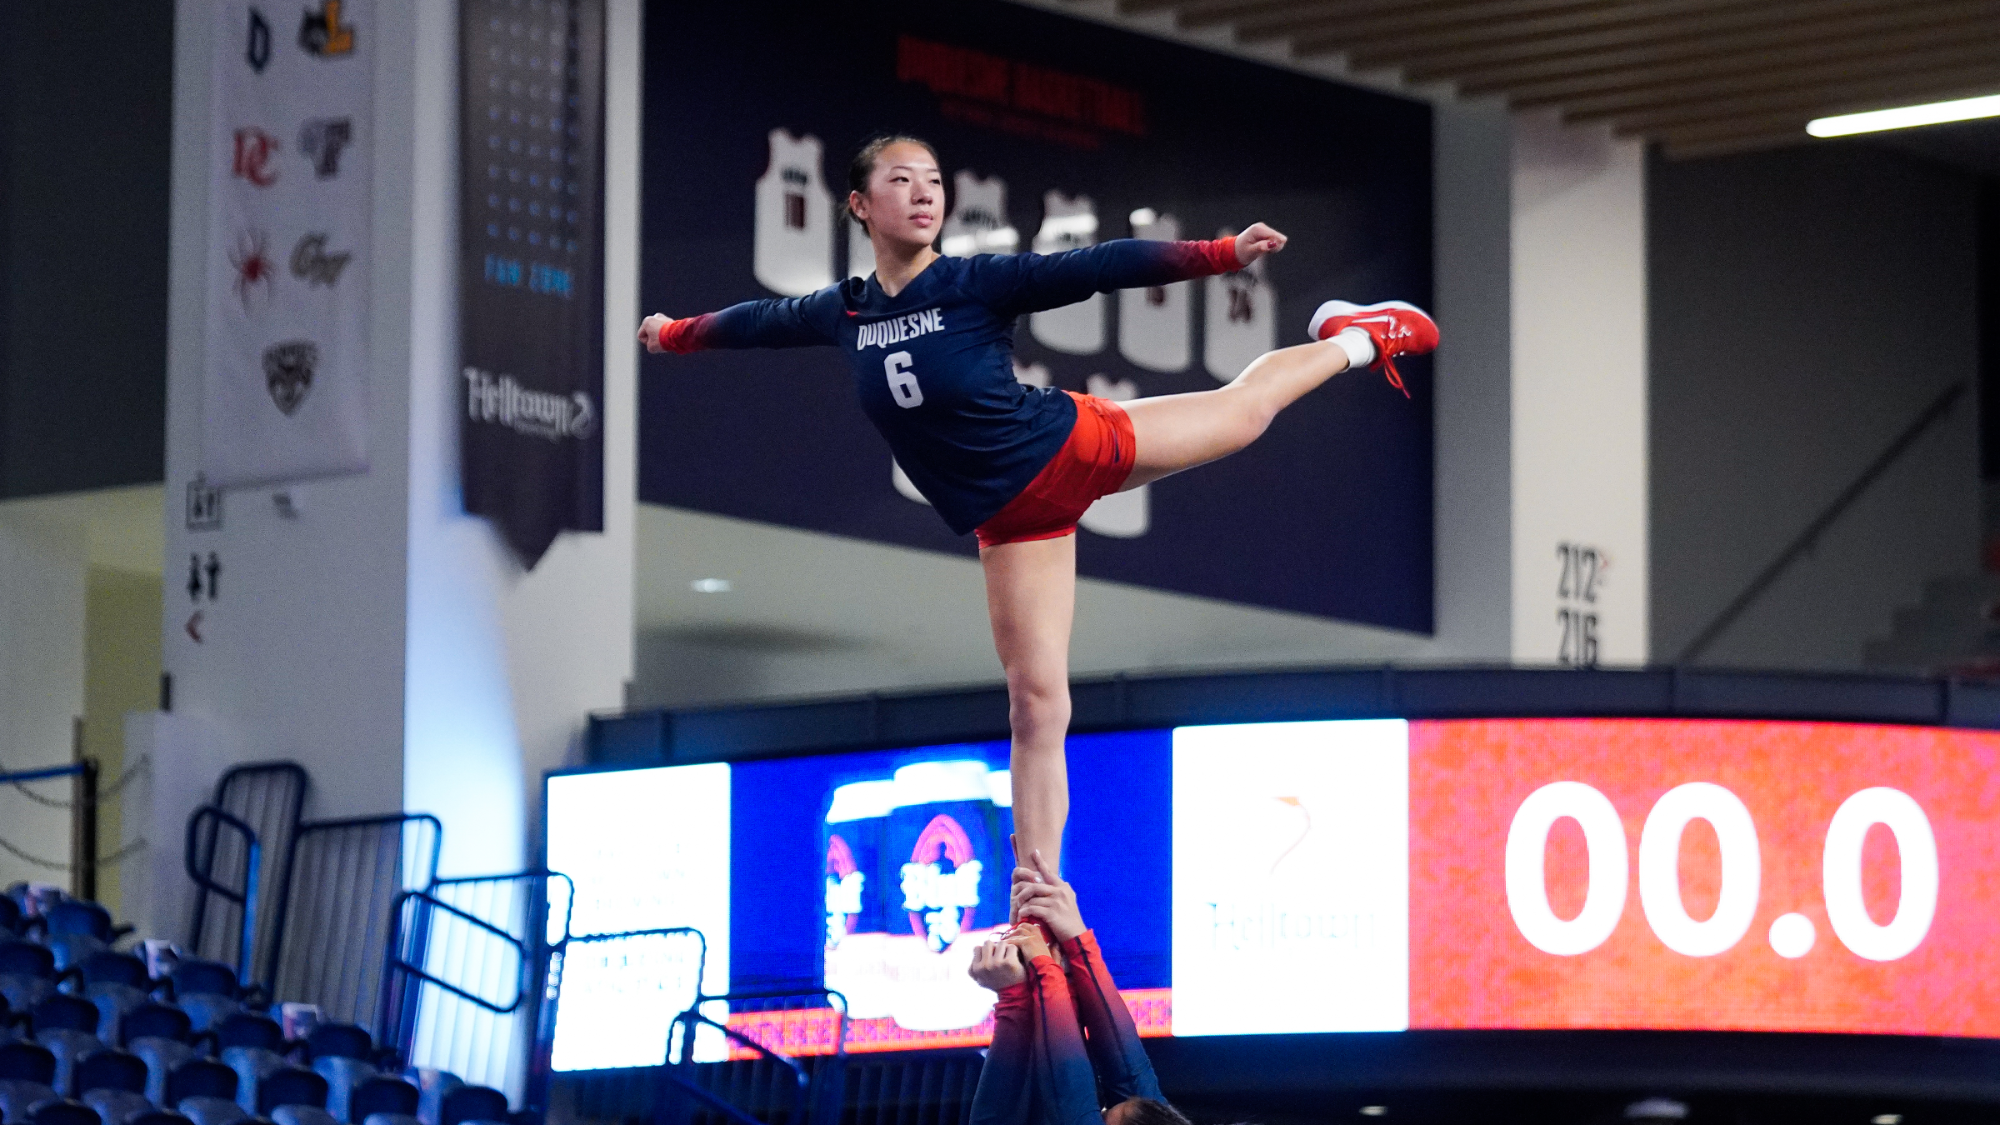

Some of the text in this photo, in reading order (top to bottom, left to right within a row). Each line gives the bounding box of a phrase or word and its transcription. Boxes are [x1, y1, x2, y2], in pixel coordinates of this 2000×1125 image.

[857, 307, 945, 351] DUQUESNE
[463, 366, 571, 437] Helltown
[884, 350, 924, 409] 6
[1557, 543, 1597, 603] 212
[1557, 608, 1598, 667] 216
[1504, 780, 1940, 962] 00.0
